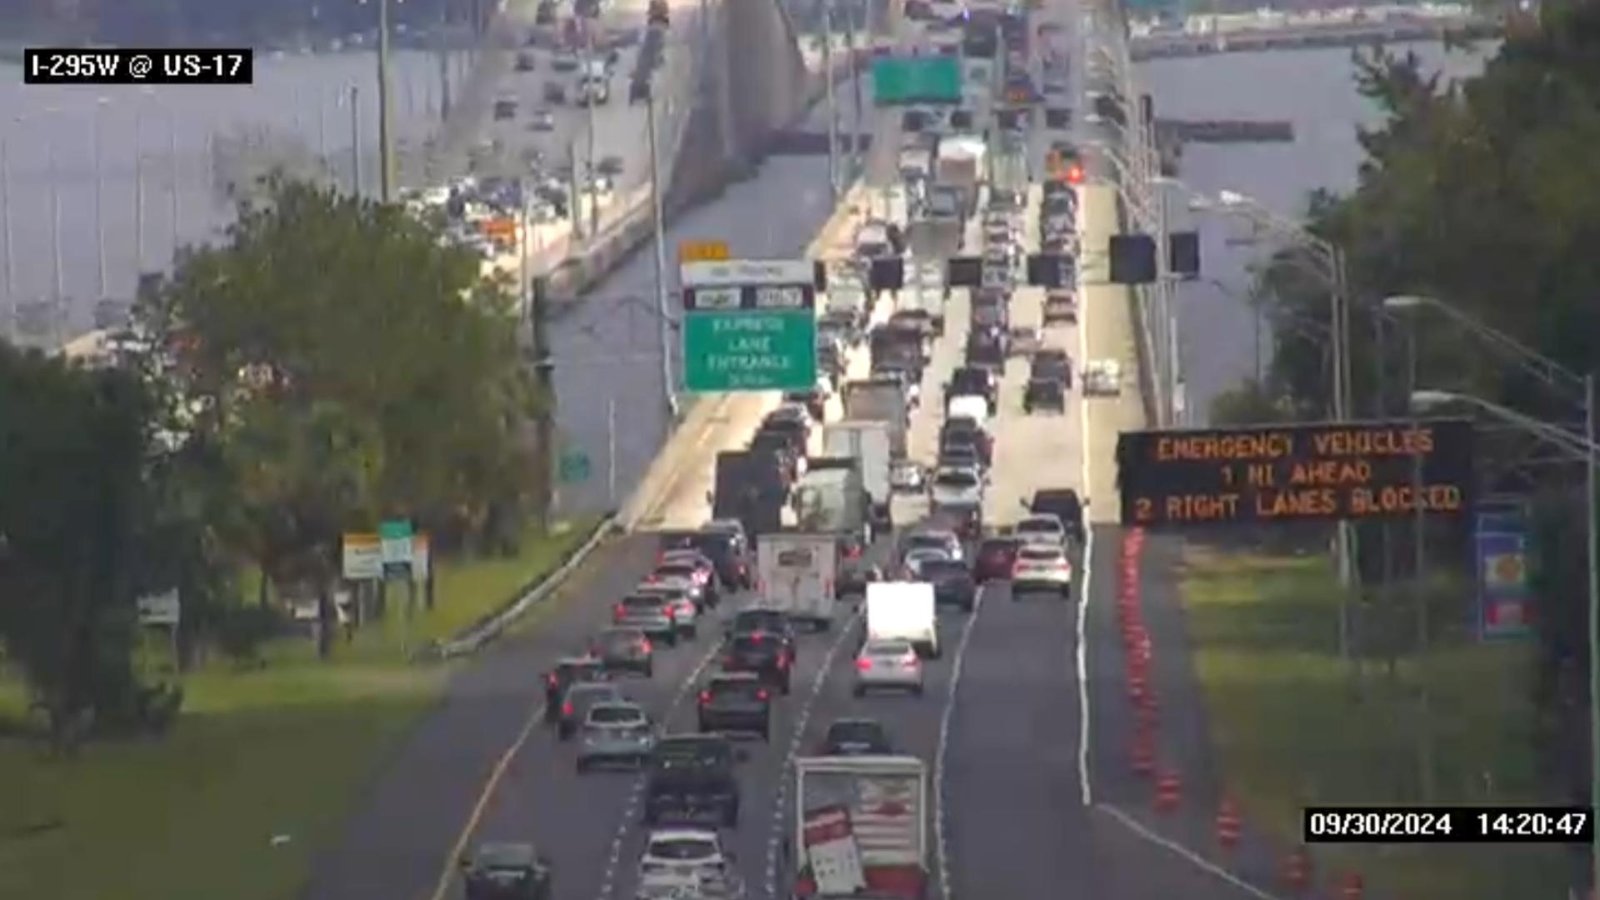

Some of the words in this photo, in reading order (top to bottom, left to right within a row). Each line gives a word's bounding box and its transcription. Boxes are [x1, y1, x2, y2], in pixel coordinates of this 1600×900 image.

[728, 337, 771, 350] LANE
[707, 355, 791, 369] ENTRANCE
[1157, 434, 1293, 460] EMERGENCY
[1313, 429, 1434, 454] VEHICLES
[1221, 466, 1232, 484] 1
[1291, 461, 1371, 483] AHEAD
[1135, 499, 1151, 520] 2
[1167, 494, 1240, 519] RIGHT
[1256, 490, 1338, 516] LANES
